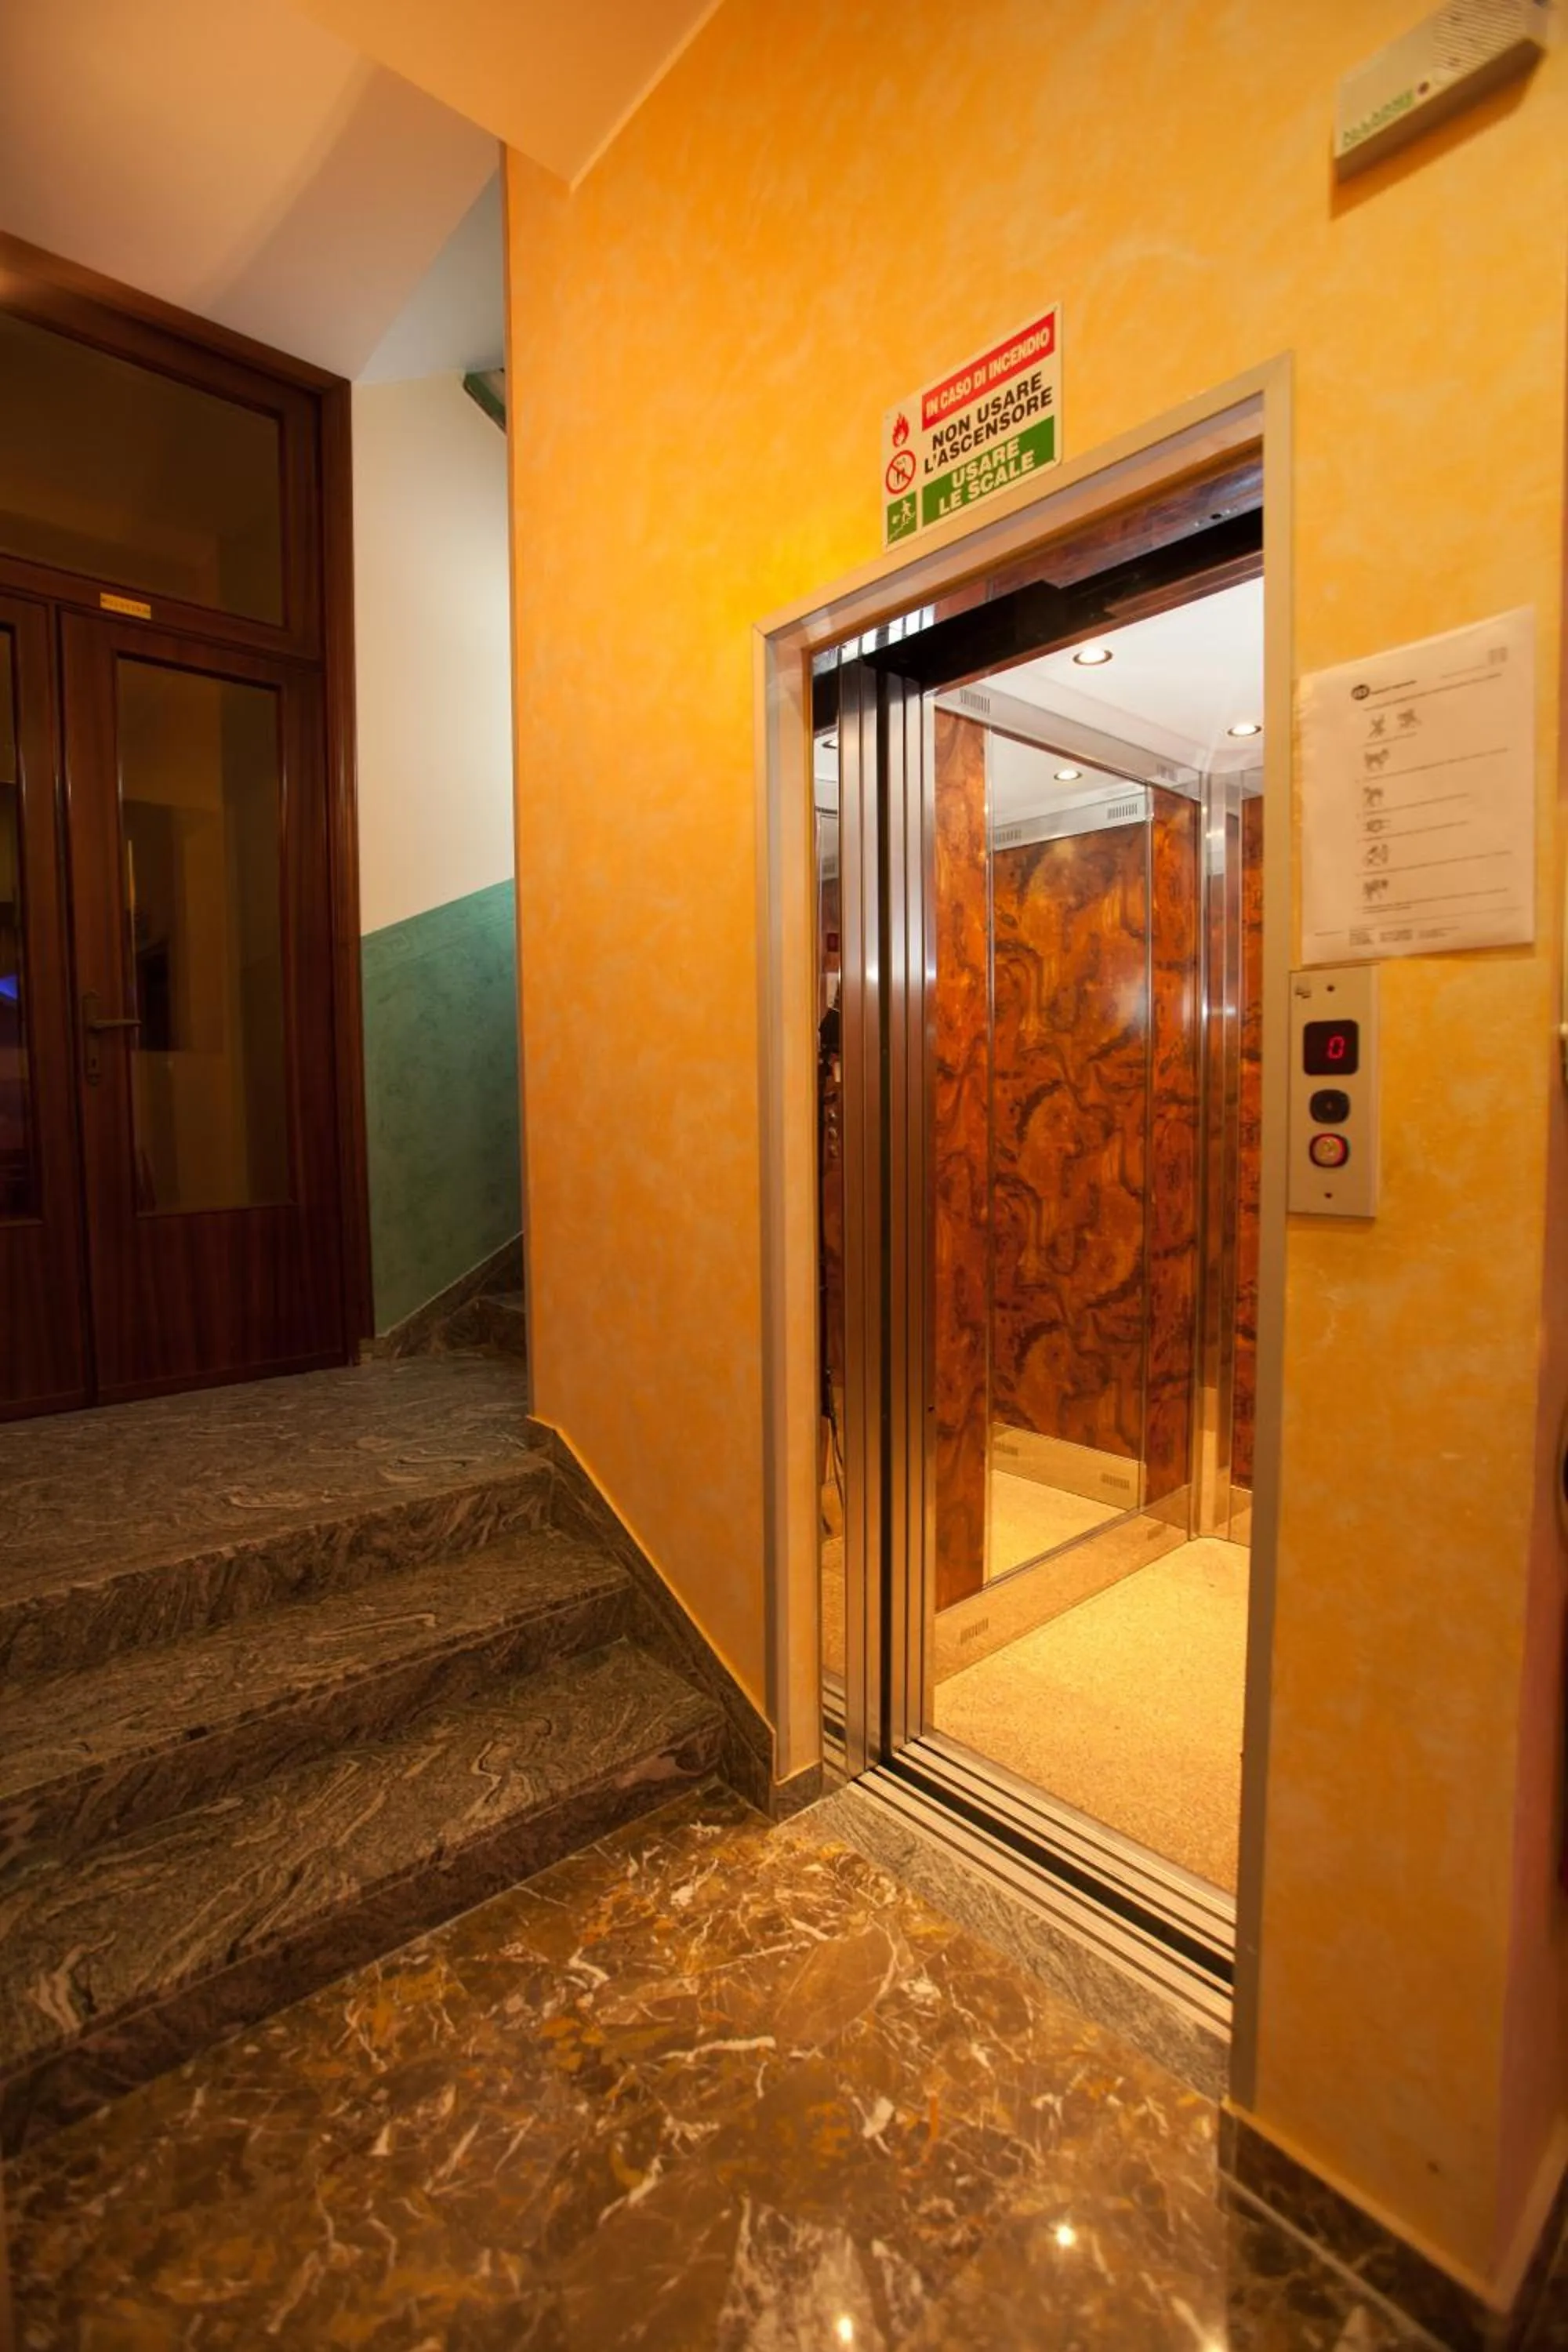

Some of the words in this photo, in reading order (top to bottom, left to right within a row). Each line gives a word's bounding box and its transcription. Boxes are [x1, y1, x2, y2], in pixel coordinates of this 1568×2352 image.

[926, 398, 938, 416] IN
[940, 378, 971, 410] CASO
[974, 368, 986, 387] DI
[989, 327, 1051, 379] INCENDIO
[924, 387, 1053, 474] L'ASCENSORE
[932, 415, 970, 451] NON
[977, 372, 1042, 423] USARE
[939, 488, 962, 515] LE
[968, 449, 1035, 496] SCALE
[952, 437, 1020, 488] USARE
